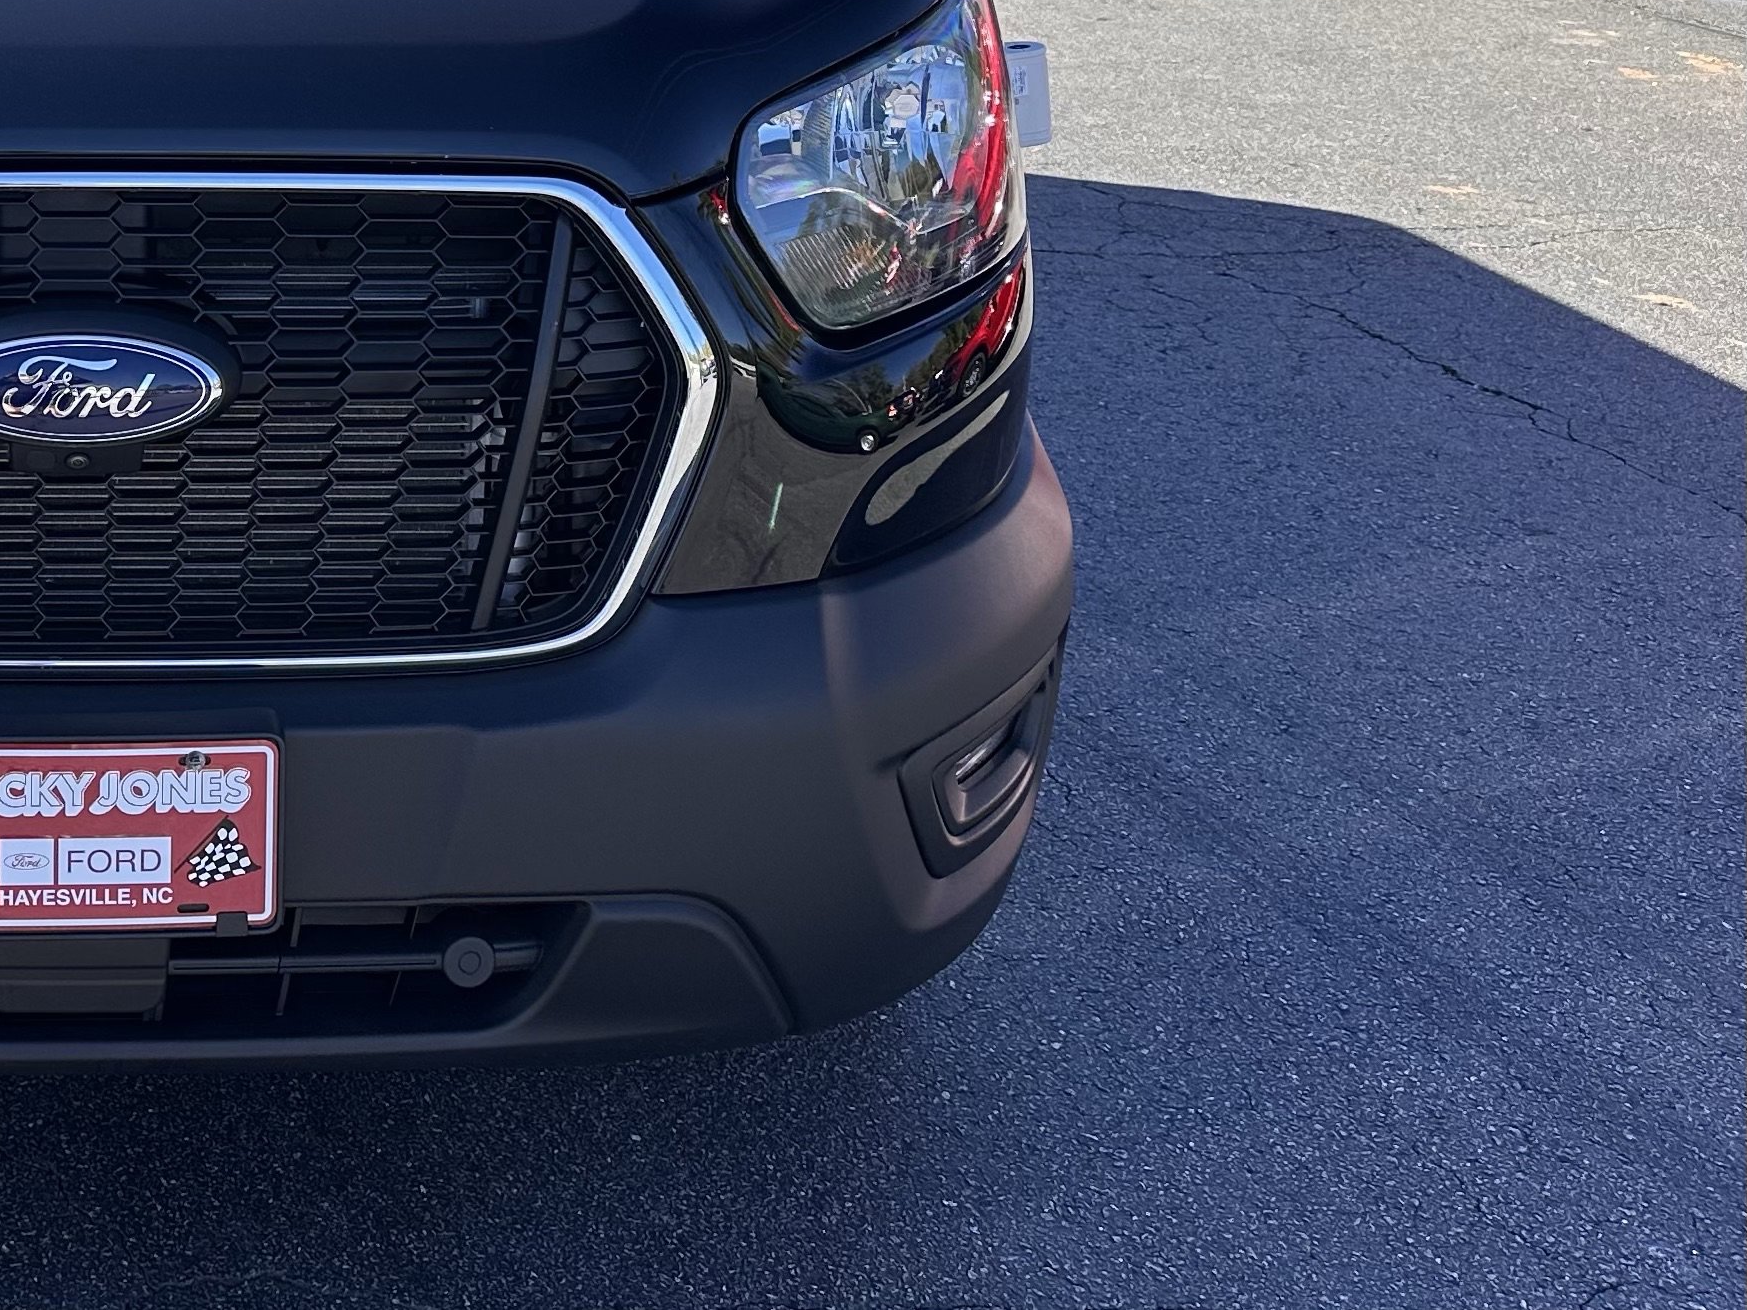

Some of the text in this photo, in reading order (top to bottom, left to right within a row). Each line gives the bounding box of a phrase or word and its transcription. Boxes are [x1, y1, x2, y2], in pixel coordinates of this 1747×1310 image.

[2, 355, 155, 418] Ford
[89, 767, 252, 815] JONES
[10, 849, 162, 874] Ford FORD
[0, 887, 173, 907] HAYESVILLE, NC
